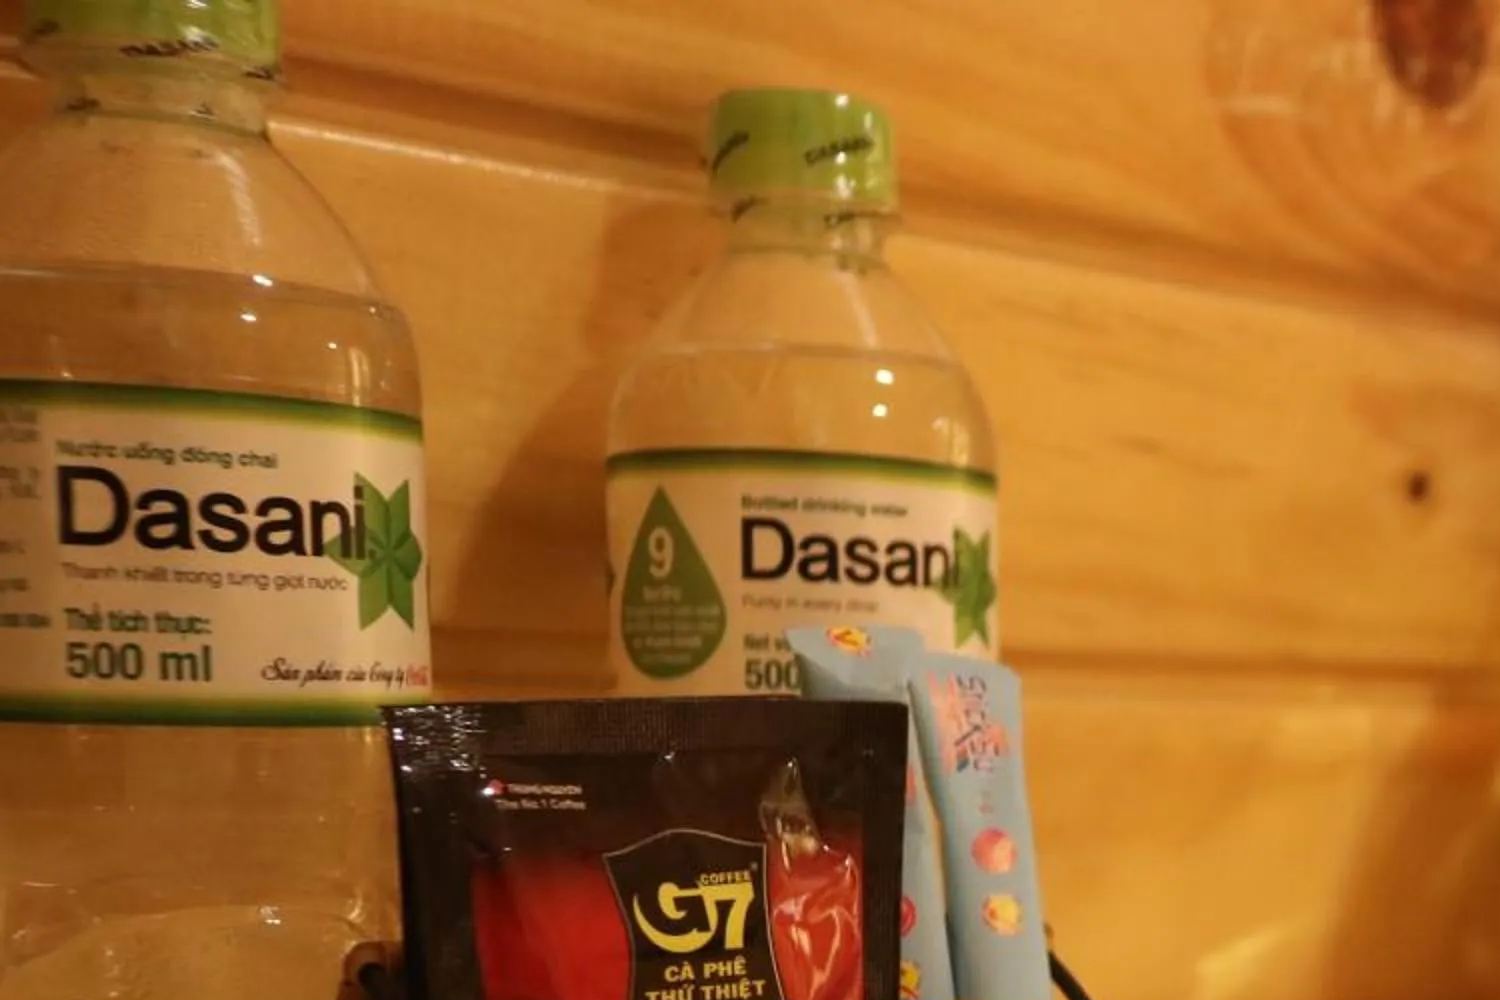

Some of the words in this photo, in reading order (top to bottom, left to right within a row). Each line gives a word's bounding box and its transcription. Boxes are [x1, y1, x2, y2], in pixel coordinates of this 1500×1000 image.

[56, 464, 364, 561] Dasani
[647, 527, 674, 579] 9
[740, 516, 960, 590] Dasani
[65, 642, 144, 681] 500
[159, 645, 213, 683] ml
[744, 658, 800, 691] 500
[701, 870, 751, 885] COFFEE
[632, 881, 756, 953] G7
[664, 961, 695, 983] CÀ
[703, 954, 747, 979] PHÊ
